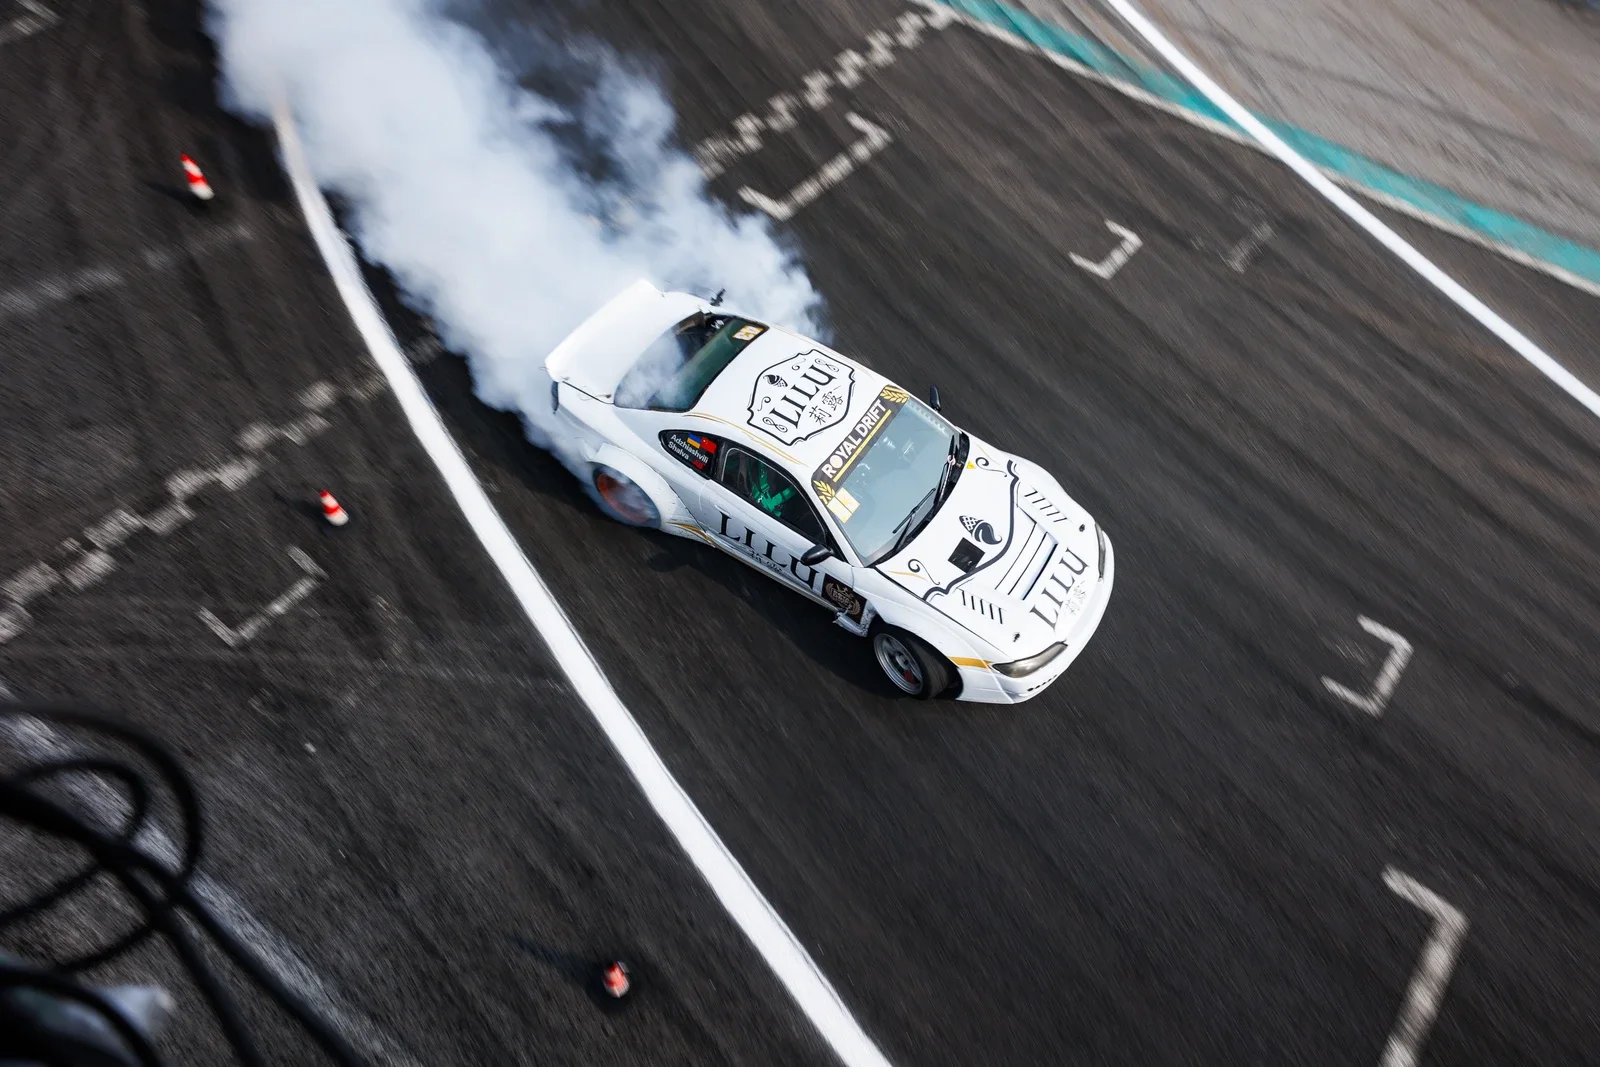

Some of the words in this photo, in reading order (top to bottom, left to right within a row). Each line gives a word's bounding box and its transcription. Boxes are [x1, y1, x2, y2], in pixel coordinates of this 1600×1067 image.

[769, 364, 838, 429] LILU
[668, 441, 690, 460] Shalva
[670, 434, 709, 464] Adzhiashvili
[821, 432, 862, 479] ROYAL
[855, 399, 887, 438] DRIFT
[719, 510, 821, 589] LILU
[1029, 547, 1090, 632] LILU
